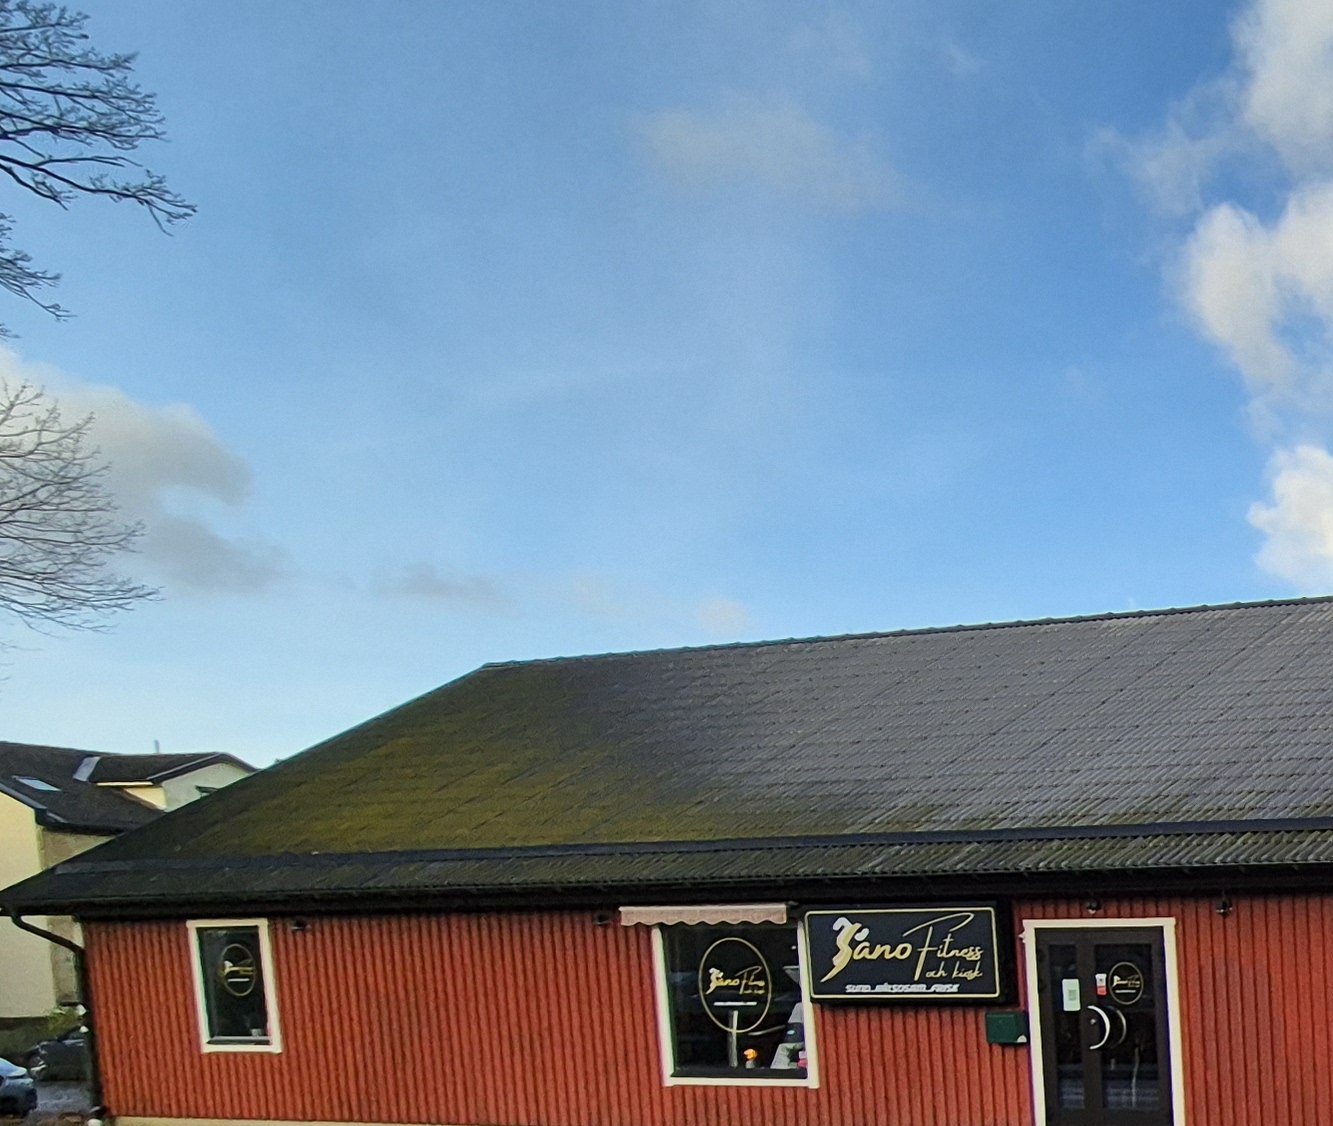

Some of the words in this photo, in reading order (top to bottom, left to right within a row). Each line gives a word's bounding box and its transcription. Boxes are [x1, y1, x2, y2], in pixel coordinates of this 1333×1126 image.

[902, 912, 984, 982] Fitness
[925, 961, 948, 978] och
[951, 961, 983, 981] kiosk
